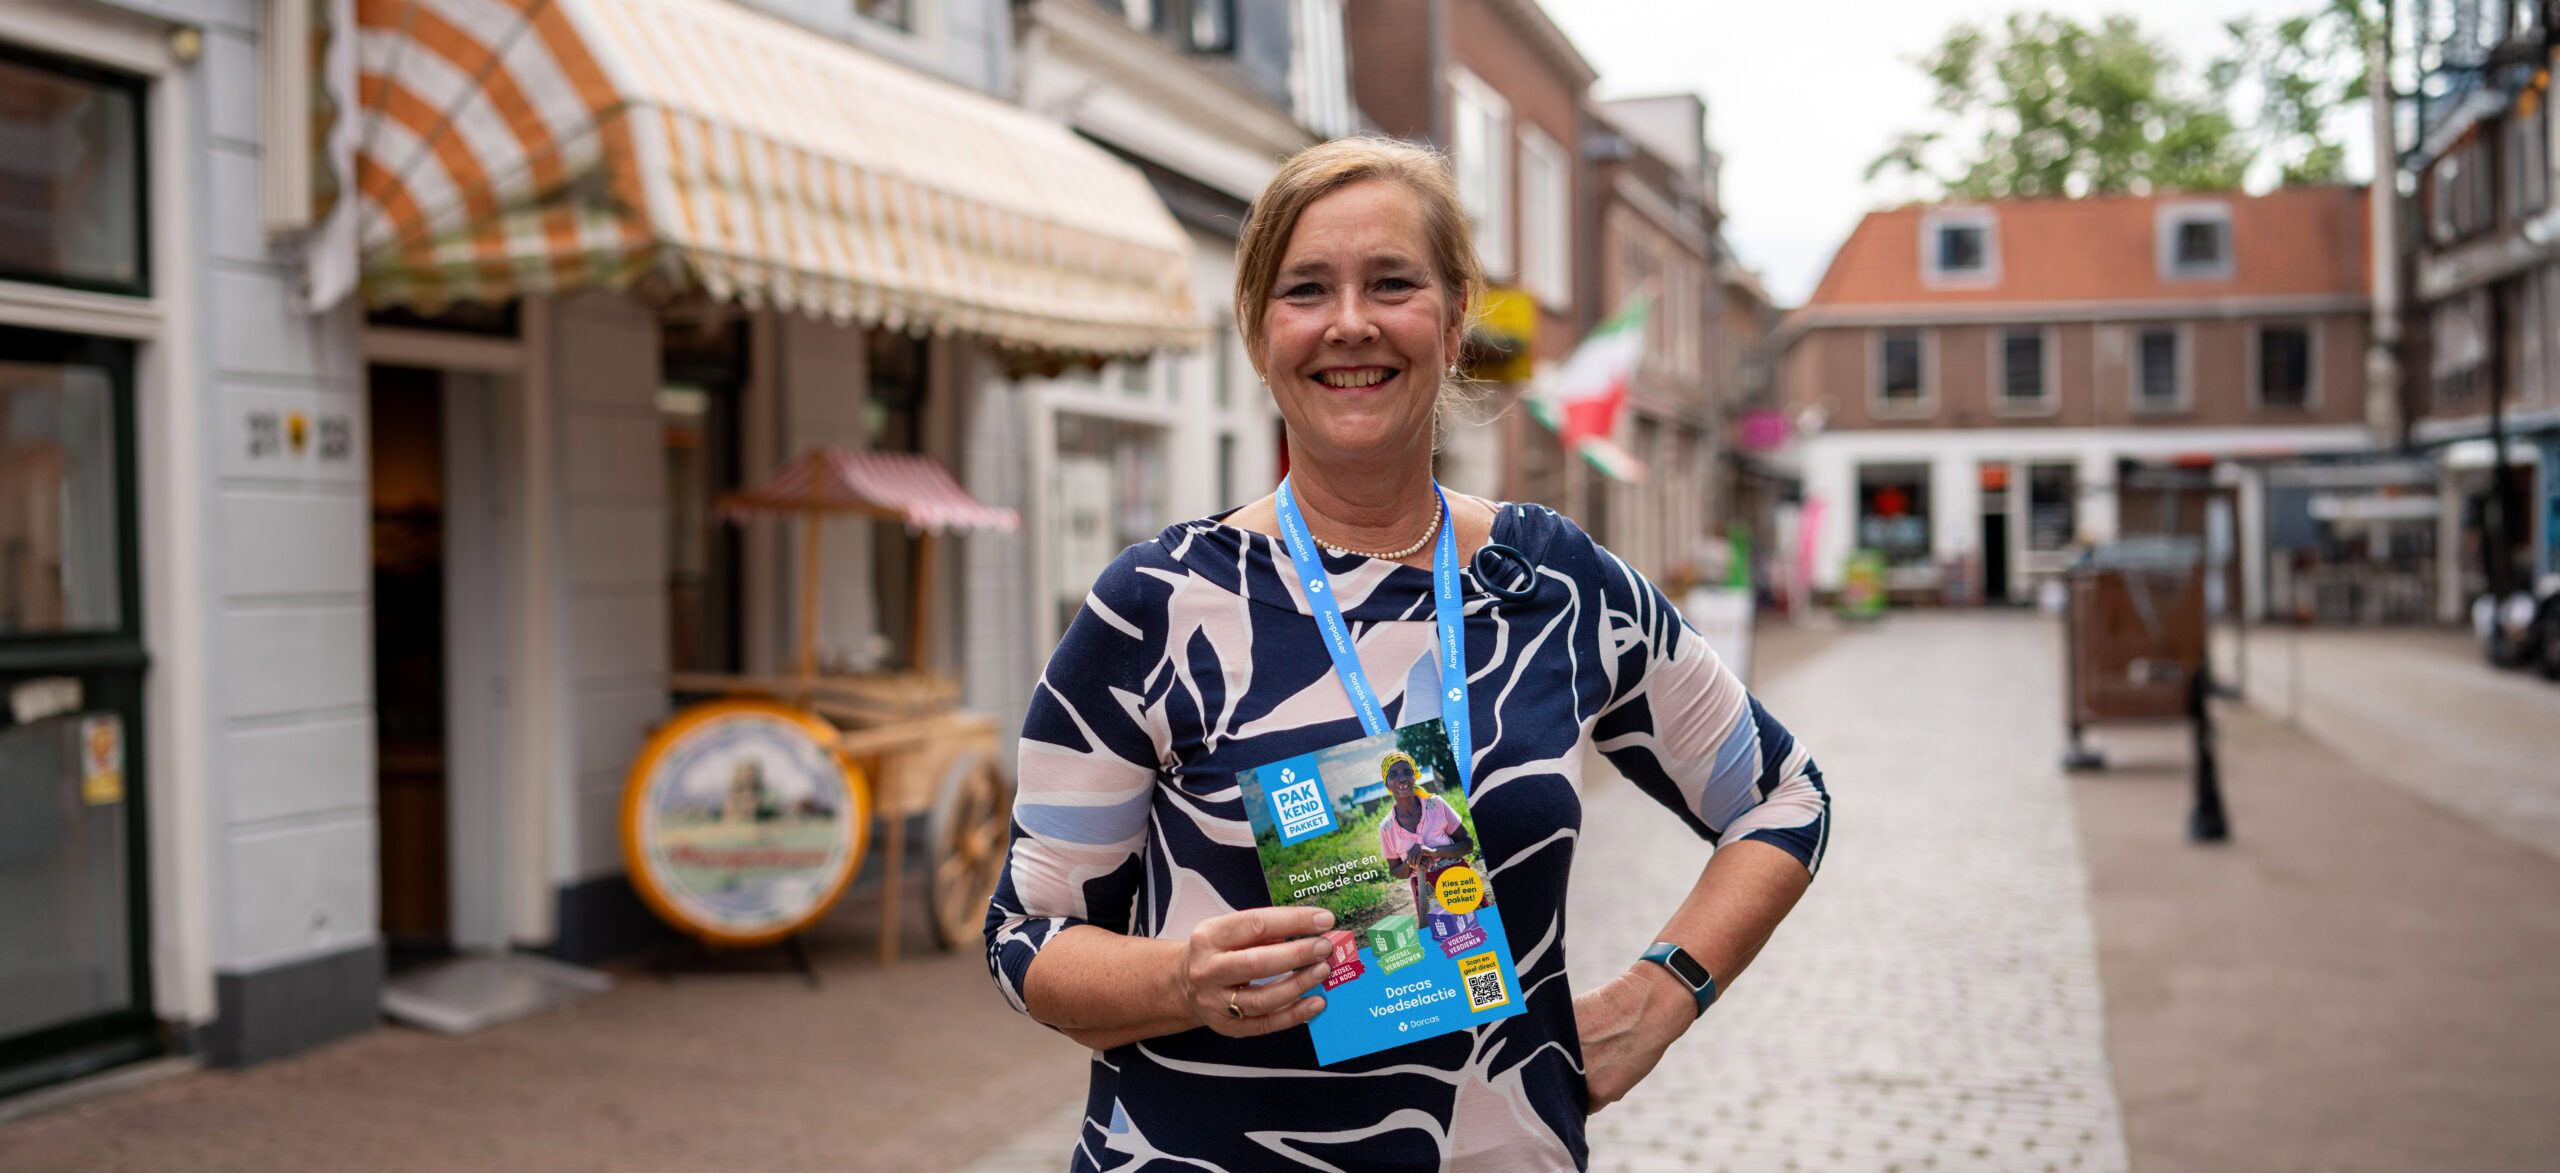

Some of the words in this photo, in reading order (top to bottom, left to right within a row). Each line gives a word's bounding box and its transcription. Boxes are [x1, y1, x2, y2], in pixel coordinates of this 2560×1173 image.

[1279, 482, 1289, 508] orcas
[1284, 511, 1310, 562] Voedselactie
[1443, 570, 1452, 599] Dorcas
[1324, 610, 1347, 654] Aanpakker
[1447, 624, 1457, 670] Aanpakker
[1349, 671, 1366, 700] Dorcas
[1278, 784, 1314, 808] PAK
[1283, 800, 1319, 820] KEND
[1289, 816, 1324, 834] PAKKET
[1288, 869, 1312, 885] Pak
[1314, 859, 1358, 879] honger
[1362, 855, 1378, 865] en
[1293, 875, 1351, 898] armoede
[1353, 869, 1379, 882] aan
[1442, 880, 1458, 888] Kies
[1443, 887, 1461, 897] geef
[1462, 886, 1477, 894] een
[1446, 894, 1476, 906] pakket!
[1447, 932, 1474, 947] VOEDSEL
[1448, 937, 1481, 955] VERDIENEN
[1384, 949, 1411, 963] VOEDSEL
[1384, 953, 1421, 972] VERBOUWEN
[1466, 958, 1481, 966] Scan
[1329, 964, 1353, 979] OEDSEL
[1463, 965, 1477, 975] geef
[1478, 961, 1496, 971] direct
[1328, 977, 1338, 987] BIJ
[1339, 970, 1357, 983] NOOD
[1385, 979, 1432, 999] Dorcas
[1369, 987, 1456, 1018] Voedselactie
[1410, 1015, 1440, 1028] Dorcas
